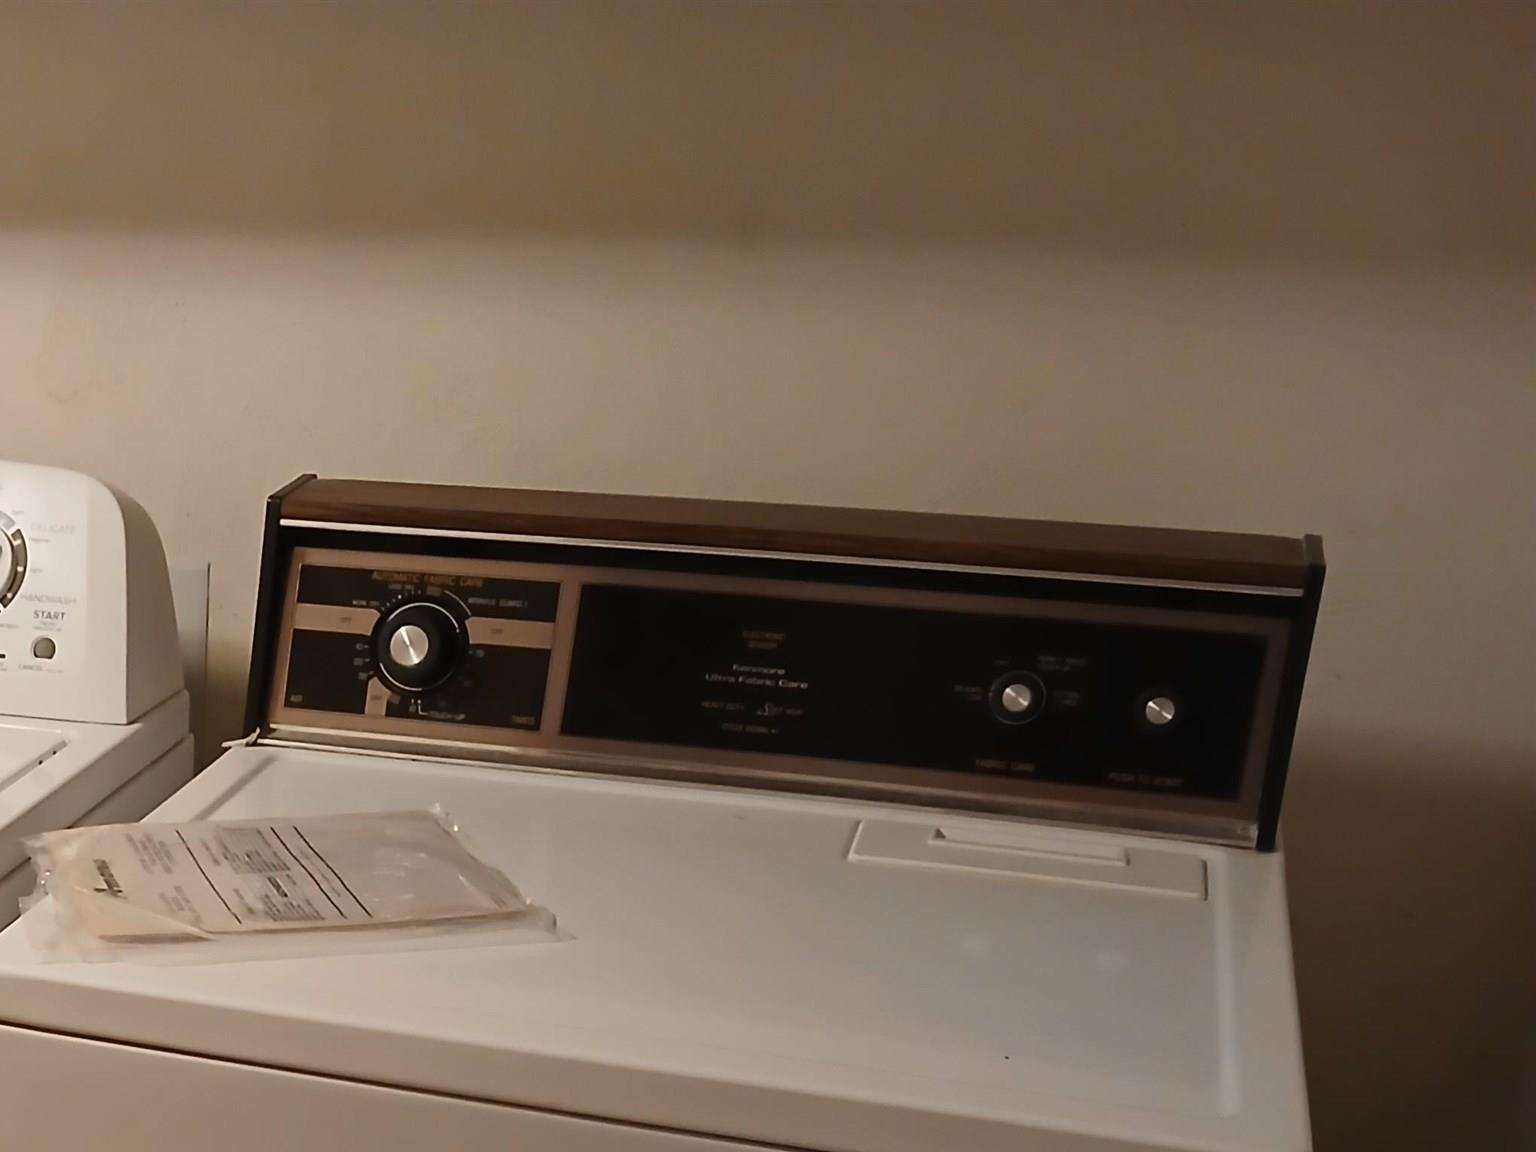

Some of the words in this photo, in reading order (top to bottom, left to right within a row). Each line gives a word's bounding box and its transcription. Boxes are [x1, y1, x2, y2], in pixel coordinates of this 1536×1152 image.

[33, 609, 67, 621] START
[732, 663, 786, 675] Kenmore
[705, 673, 736, 684] Ultra
[738, 676, 776, 687] Fabric
[778, 679, 809, 690] Care
